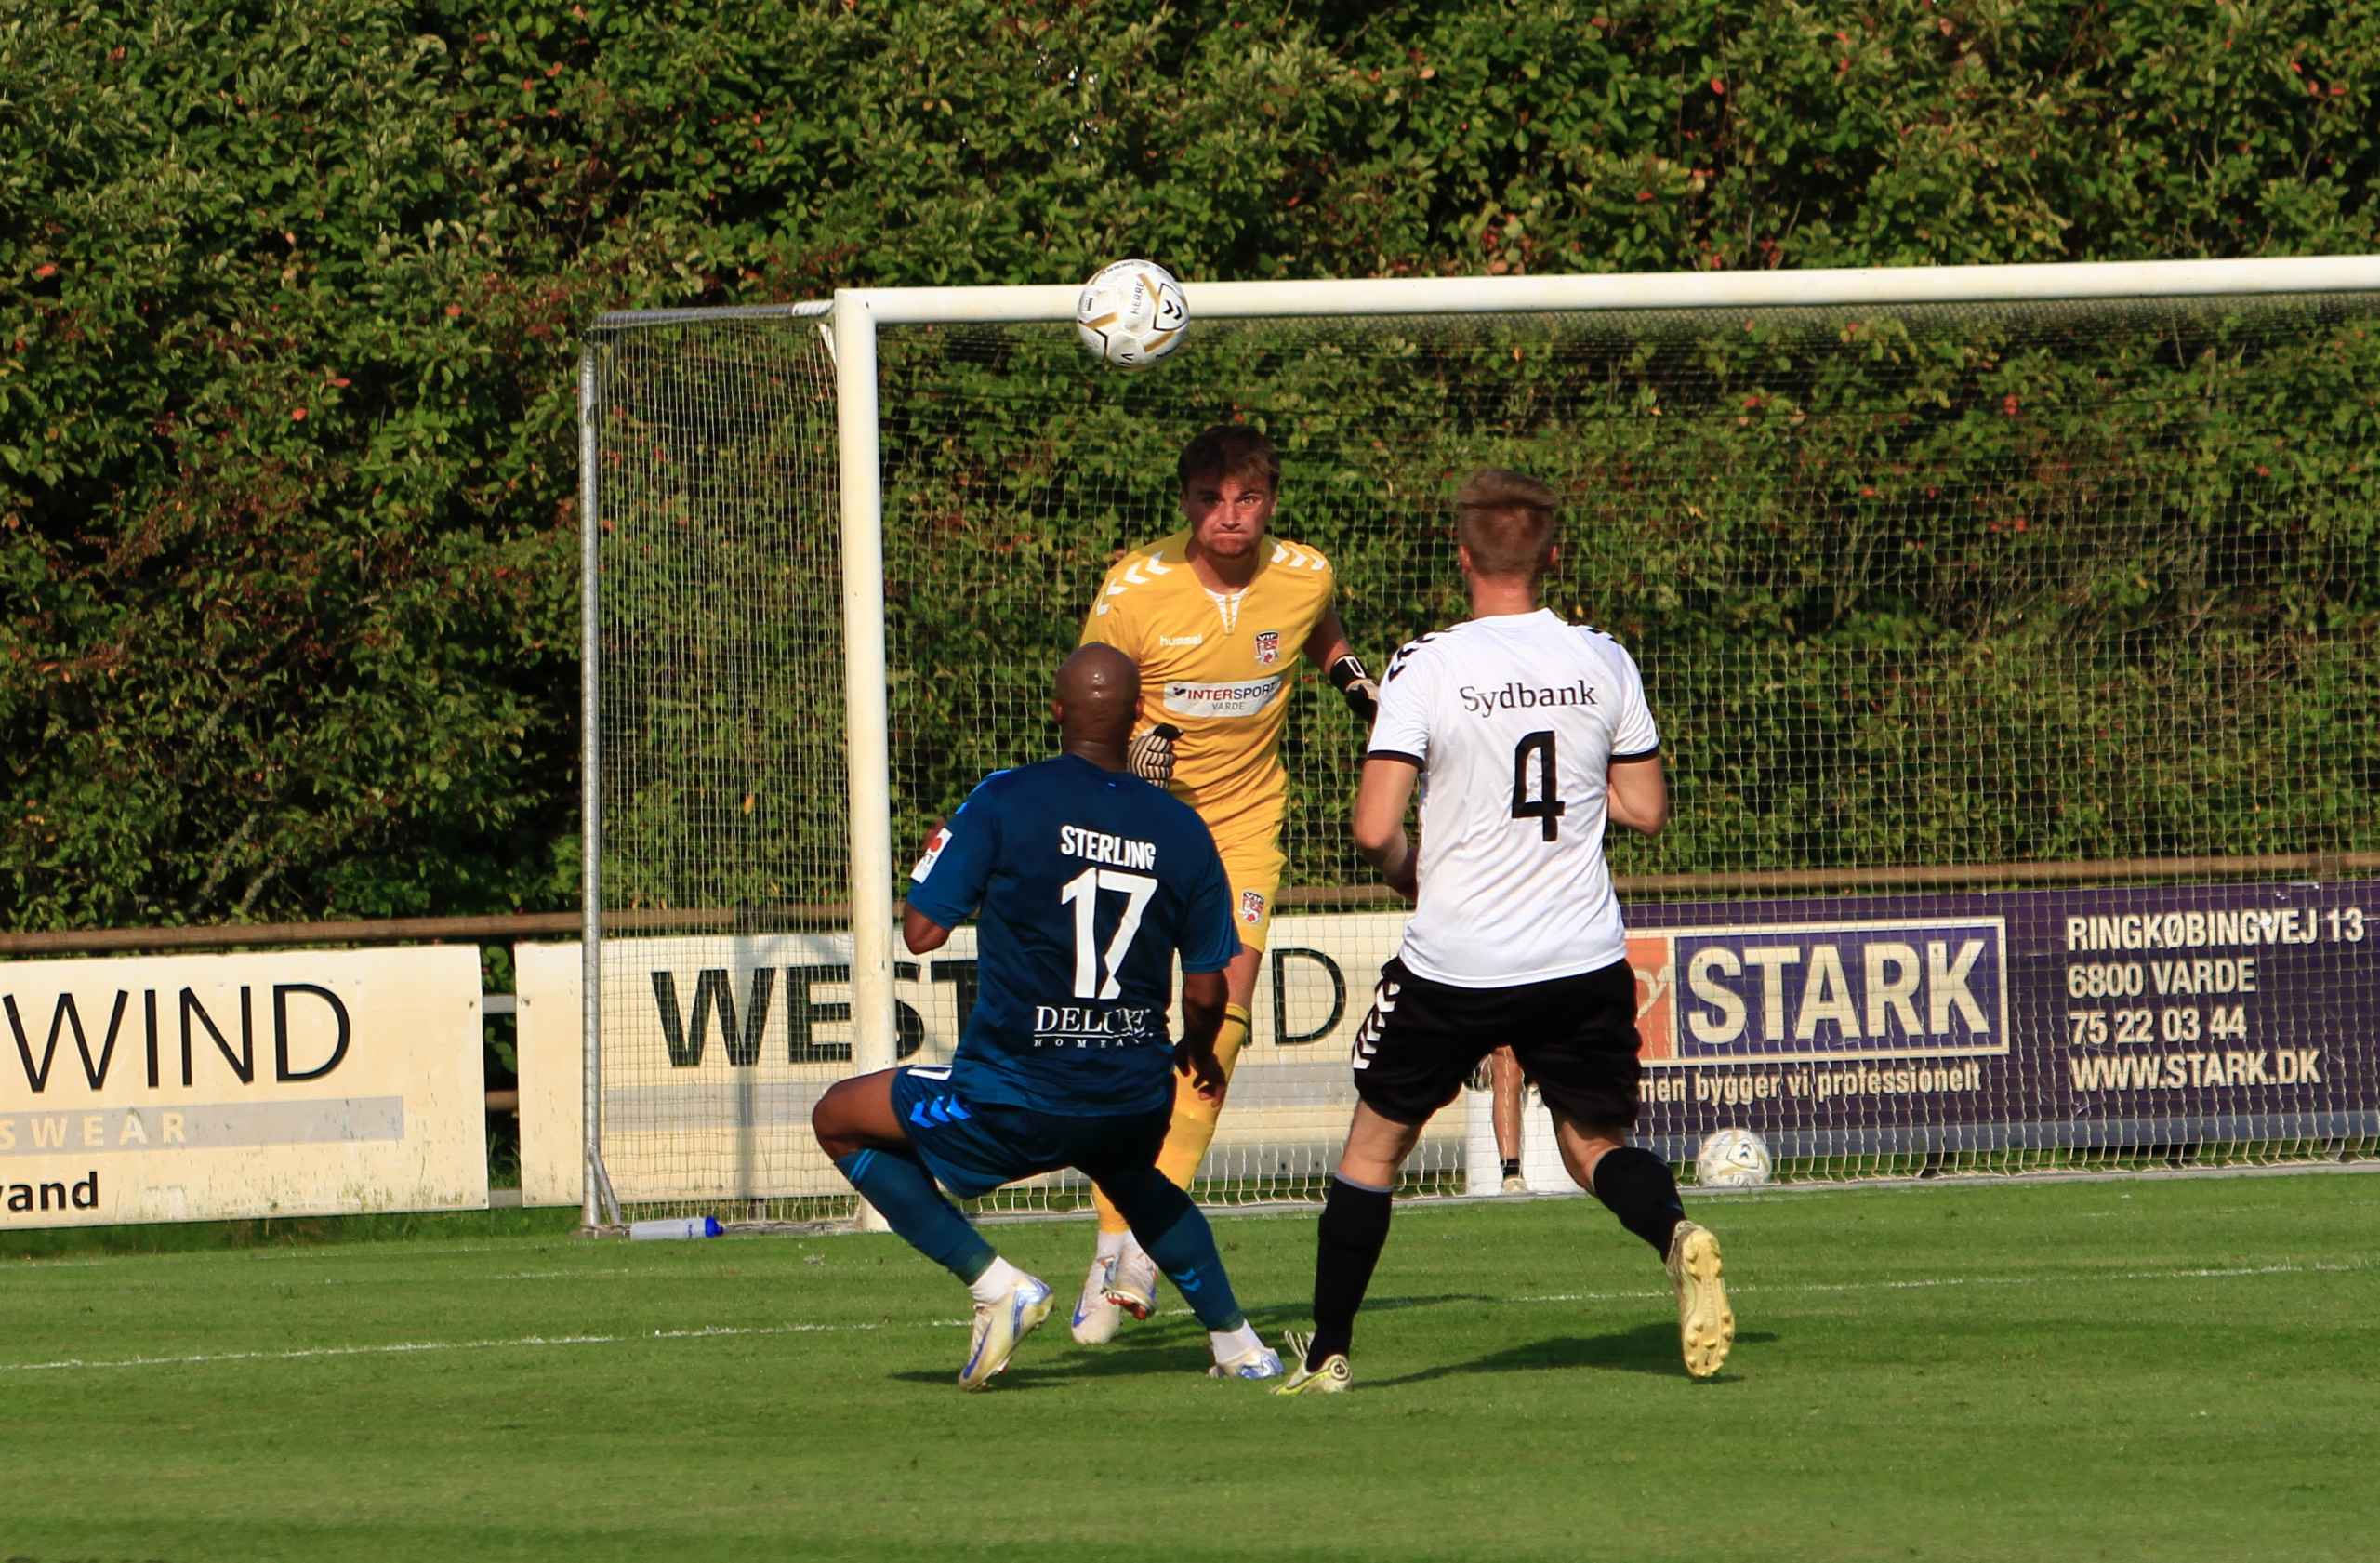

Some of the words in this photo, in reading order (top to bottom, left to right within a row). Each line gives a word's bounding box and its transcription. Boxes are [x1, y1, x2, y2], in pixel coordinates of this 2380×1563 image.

[1188, 682, 1276, 700] INTERSPORT
[1212, 701, 1247, 711] VARDE
[1460, 680, 1598, 718] Sydbank
[1511, 730, 1566, 842] 4
[1060, 825, 1157, 870] STERLING
[1061, 867, 1158, 1000] 17
[2067, 908, 2318, 951] RINGKØBINGVEJ
[2328, 907, 2365, 942] 13
[1687, 939, 1991, 1044] STARK
[2068, 962, 2144, 999] 6800
[2152, 957, 2256, 995] VARDE
[2, 984, 351, 1093] WIND
[2069, 1012, 2109, 1045] 75
[2115, 1008, 2155, 1043] 22
[2162, 1007, 2202, 1041] 03
[2209, 1004, 2247, 1040] 44
[1695, 1072, 1781, 1106] bygger
[1786, 1069, 1809, 1097] vi
[1817, 1064, 1982, 1103] professionelt
[2070, 1049, 2322, 1092] WWW.STARK.DK
[0, 1171, 99, 1212] and
